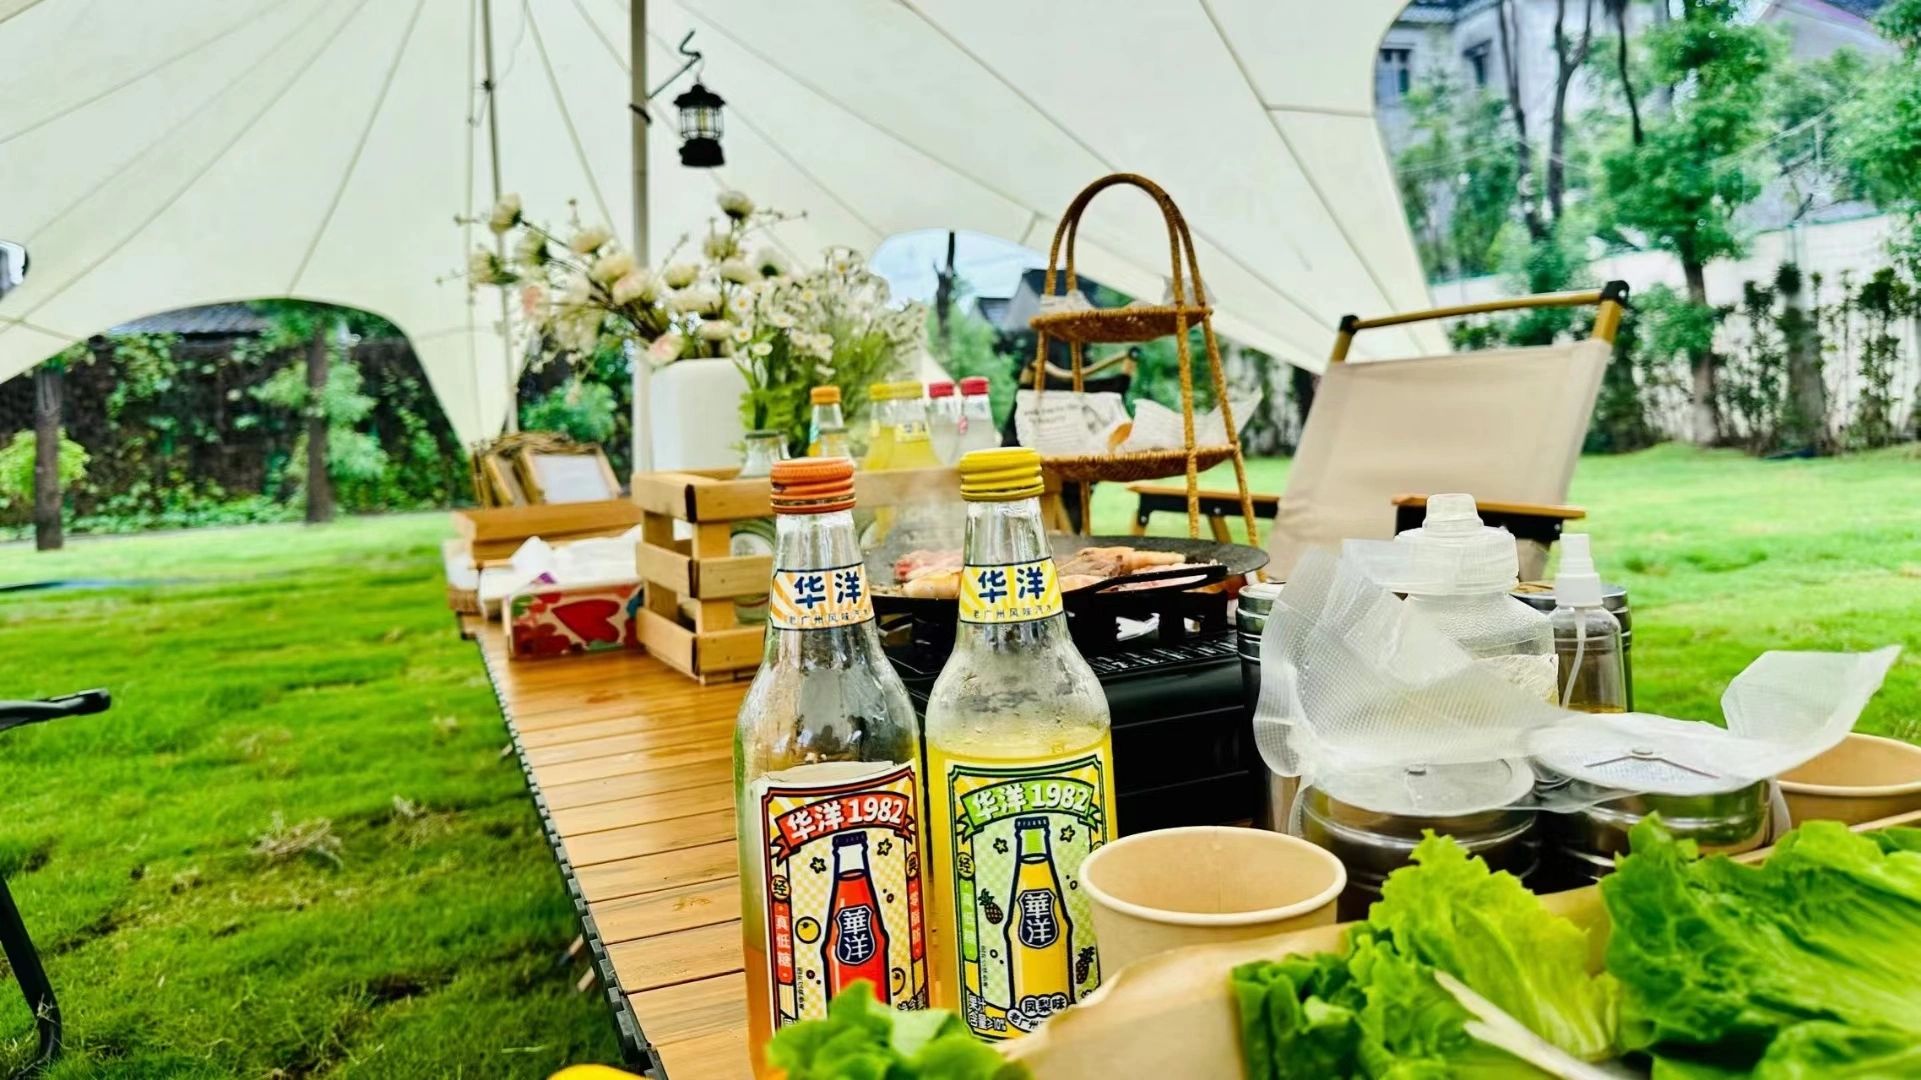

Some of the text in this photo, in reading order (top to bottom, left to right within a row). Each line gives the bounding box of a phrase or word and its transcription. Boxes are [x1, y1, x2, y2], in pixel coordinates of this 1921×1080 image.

[793, 566, 861, 609] 华洋
[978, 566, 1045, 603] 华洋
[843, 910, 869, 960] 華洋
[1025, 893, 1052, 943] 華洋
[1009, 1011, 1042, 1029] 老广州
[1024, 997, 1066, 1013] 凤梨味
